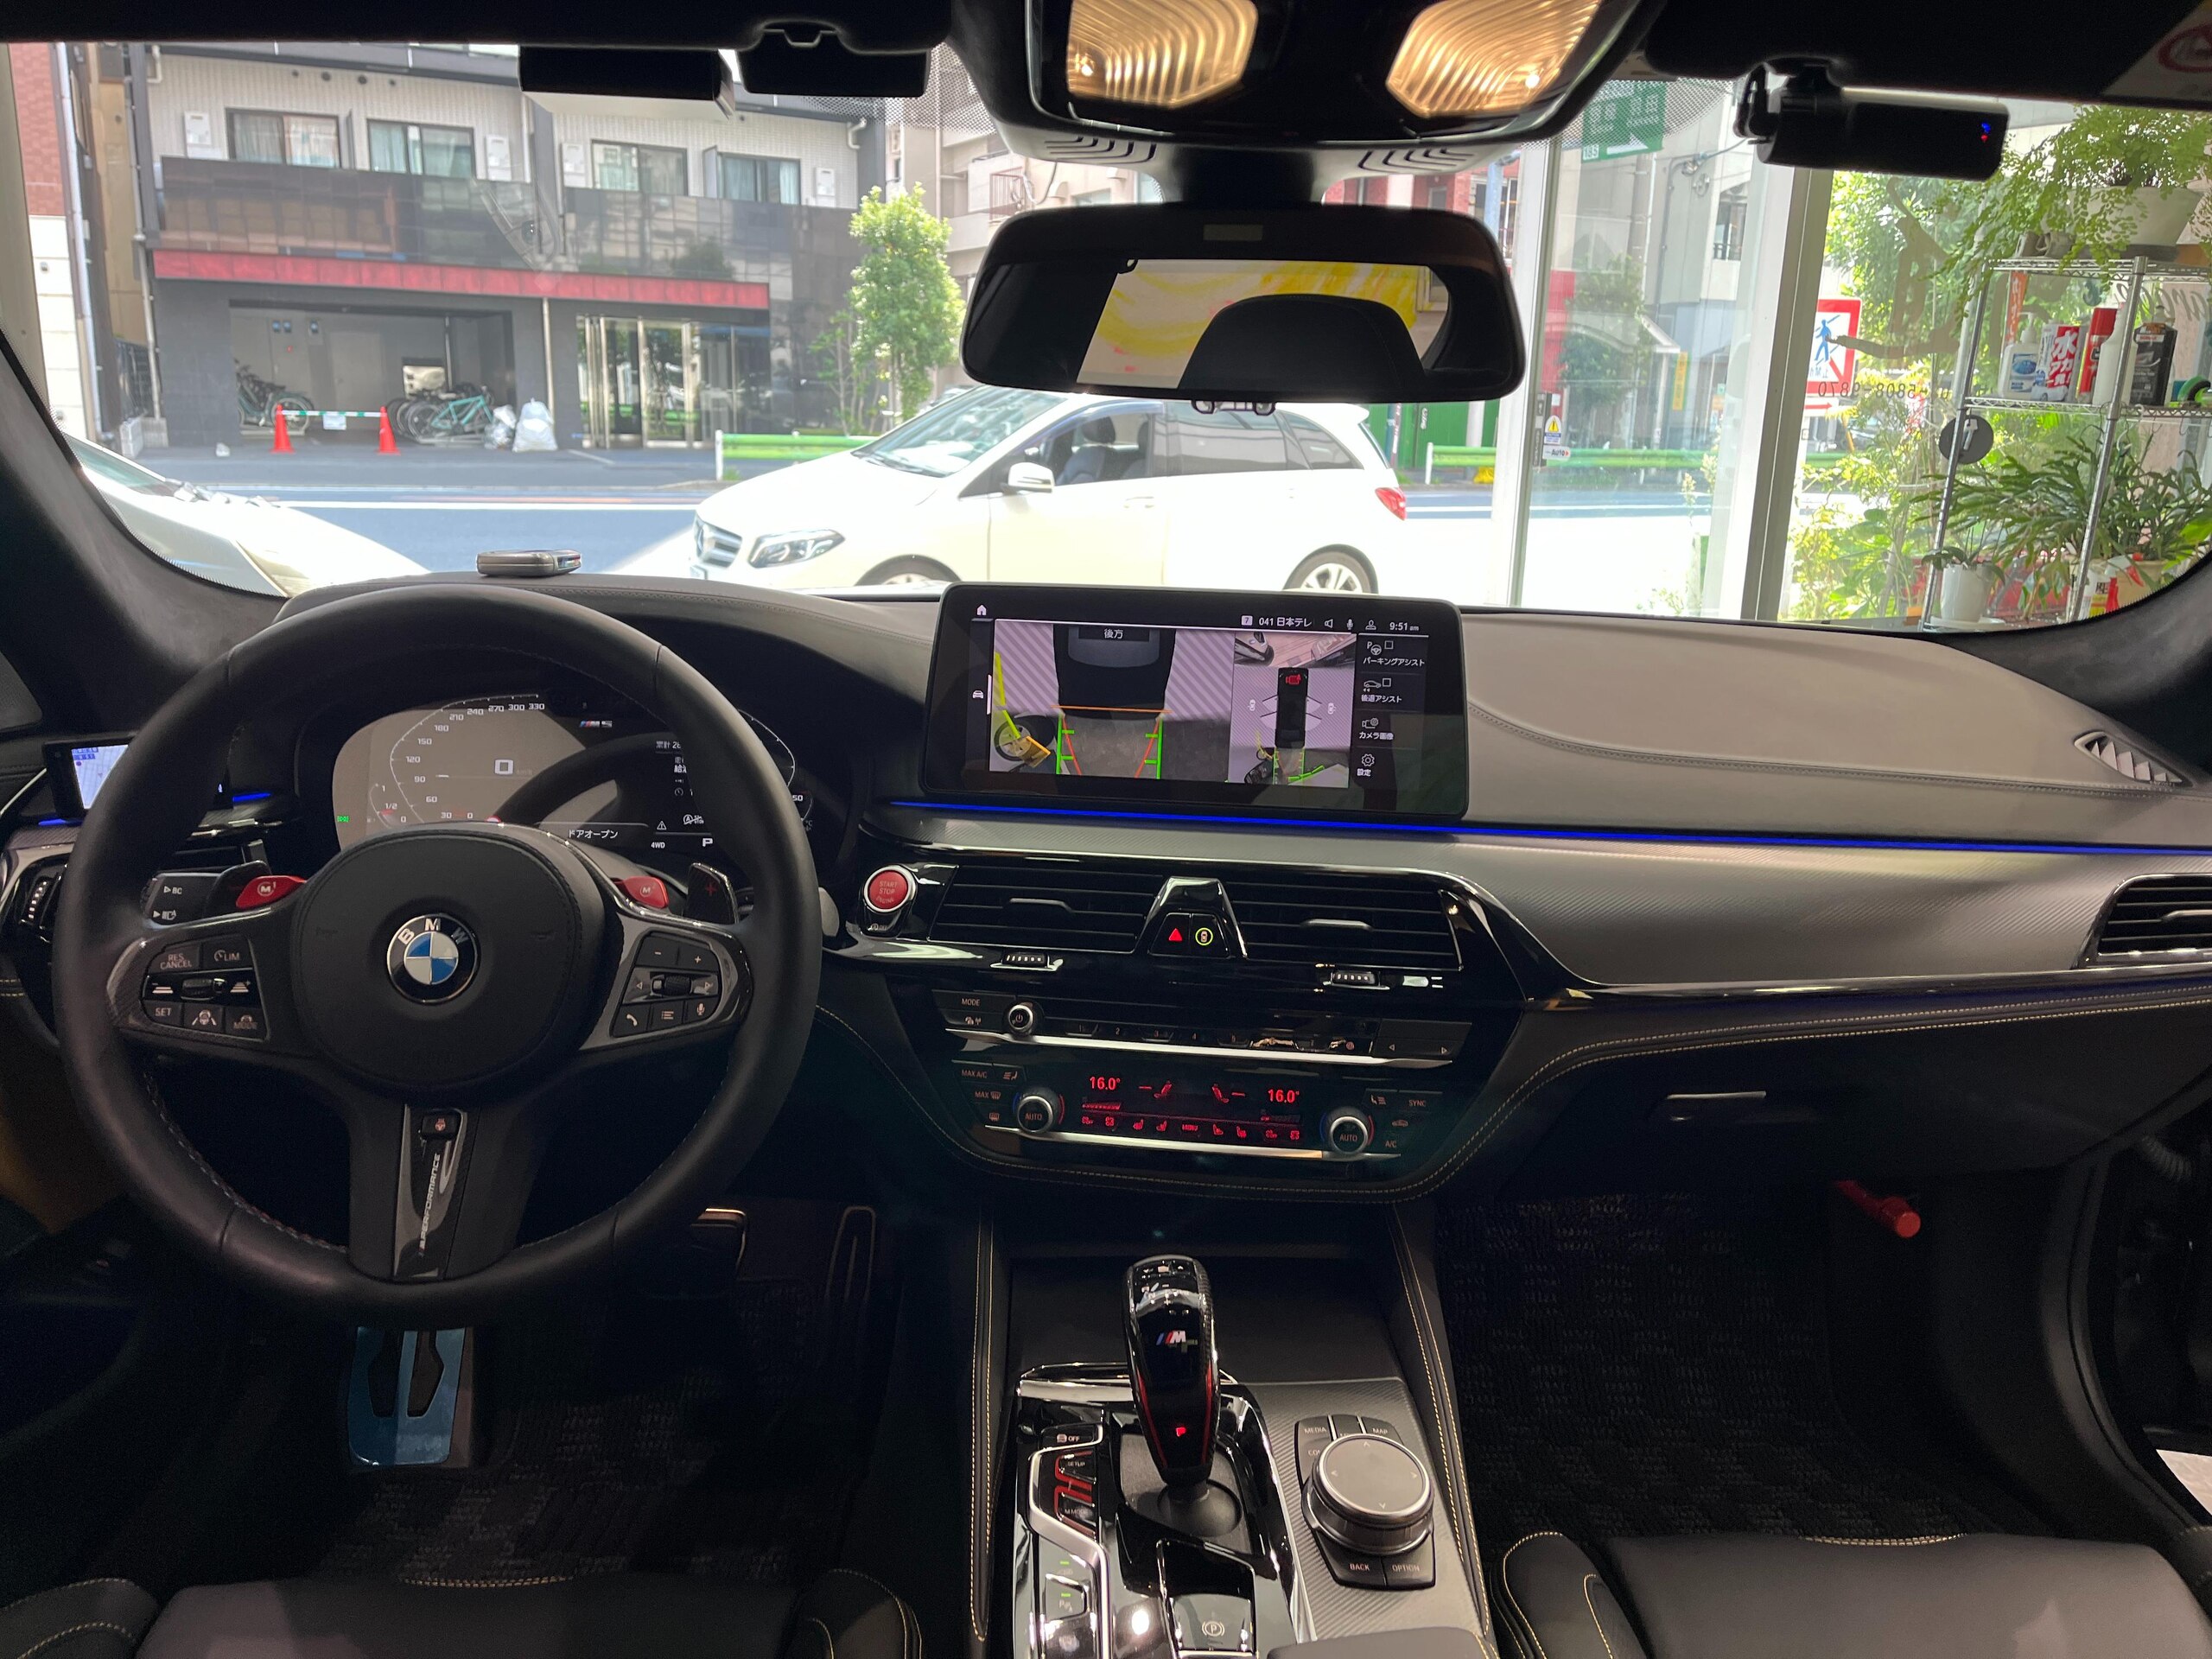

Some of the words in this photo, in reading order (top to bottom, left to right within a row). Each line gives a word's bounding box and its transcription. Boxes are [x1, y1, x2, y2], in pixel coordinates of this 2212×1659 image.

[1258, 617, 1274, 626] 041
[1276, 617, 1313, 627] 日本テレ
[1389, 622, 1408, 631] 9:51
[1363, 657, 1426, 667] パーキングアシスト
[494, 759, 514, 775] 0
[568, 830, 619, 839] ドアオープン
[702, 837, 714, 848] P
[397, 918, 469, 945] BMW
[225, 952, 240, 961] LIM
[160, 960, 193, 969] CANCEL
[961, 998, 981, 1007] MODE
[156, 1007, 172, 1016] SET
[1025, 1112, 1043, 1121] AUTO
[1339, 1134, 1358, 1142] AUTO
